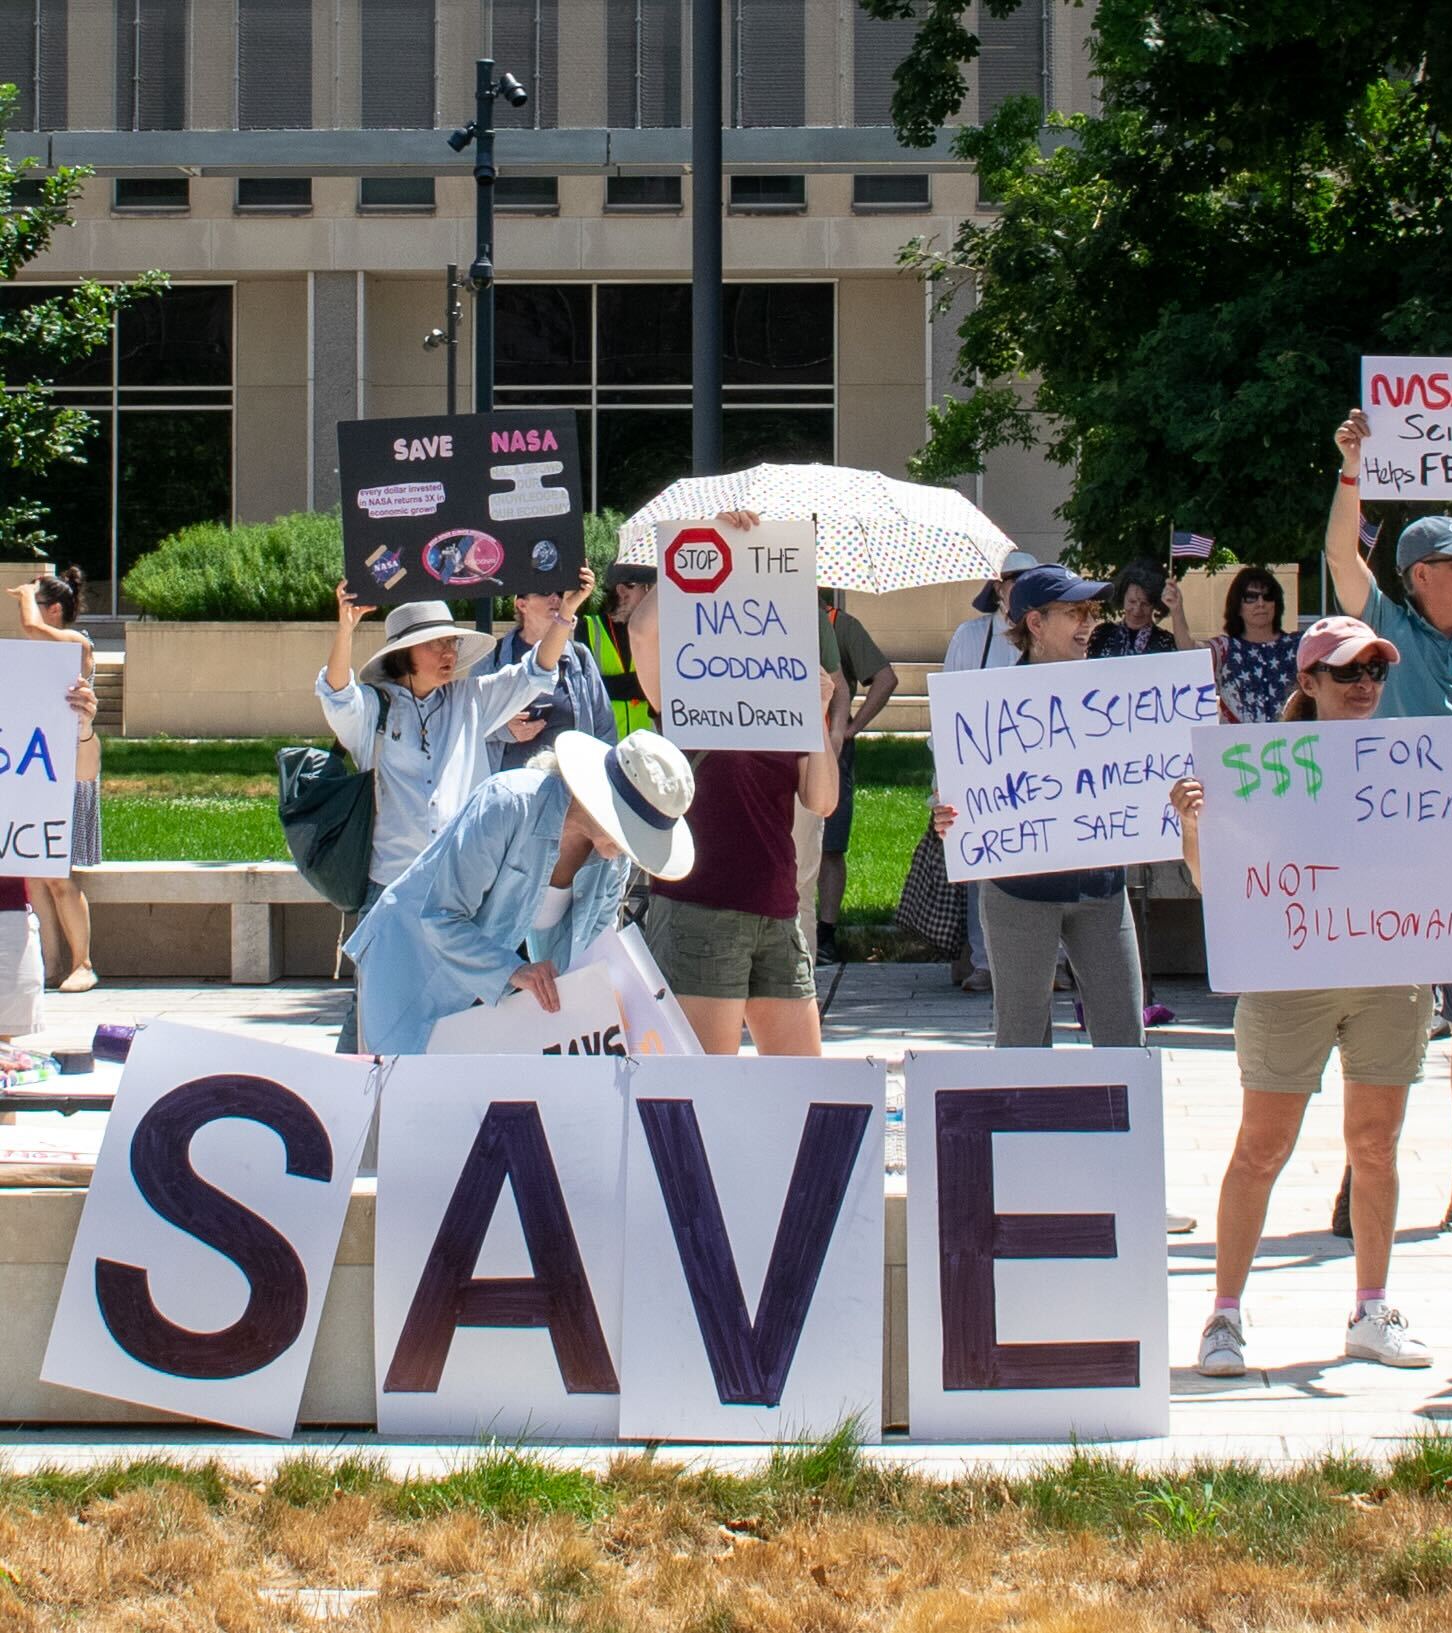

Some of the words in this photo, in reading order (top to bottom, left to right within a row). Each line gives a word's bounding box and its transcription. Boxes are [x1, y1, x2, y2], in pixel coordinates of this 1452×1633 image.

[393, 435, 454, 462] SAVE
[490, 429, 558, 454] NASA
[359, 488, 382, 497] every
[383, 486, 406, 495] dollar
[408, 484, 442, 493] invested
[1364, 457, 1416, 493] Helps
[368, 497, 392, 506] NASA
[394, 496, 422, 505] returns
[369, 508, 408, 517] economic
[373, 559, 399, 573] NASA
[677, 549, 719, 570] STOP
[748, 547, 799, 573] THE
[696, 599, 787, 636] NASA
[676, 643, 807, 681] GODDARD
[671, 699, 734, 727] BRAIN
[738, 701, 804, 727] DRAIN
[956, 695, 1077, 765] NASA
[1082, 684, 1218, 737] SCIENCE
[1221, 734, 1324, 803] $$$
[1355, 734, 1444, 772] FOR
[965, 771, 1063, 824] MAKES
[1076, 753, 1195, 799] AMERICA
[960, 817, 1058, 866] GREAT
[1074, 805, 1140, 842] SAFE
[1246, 861, 1341, 899] NOT
